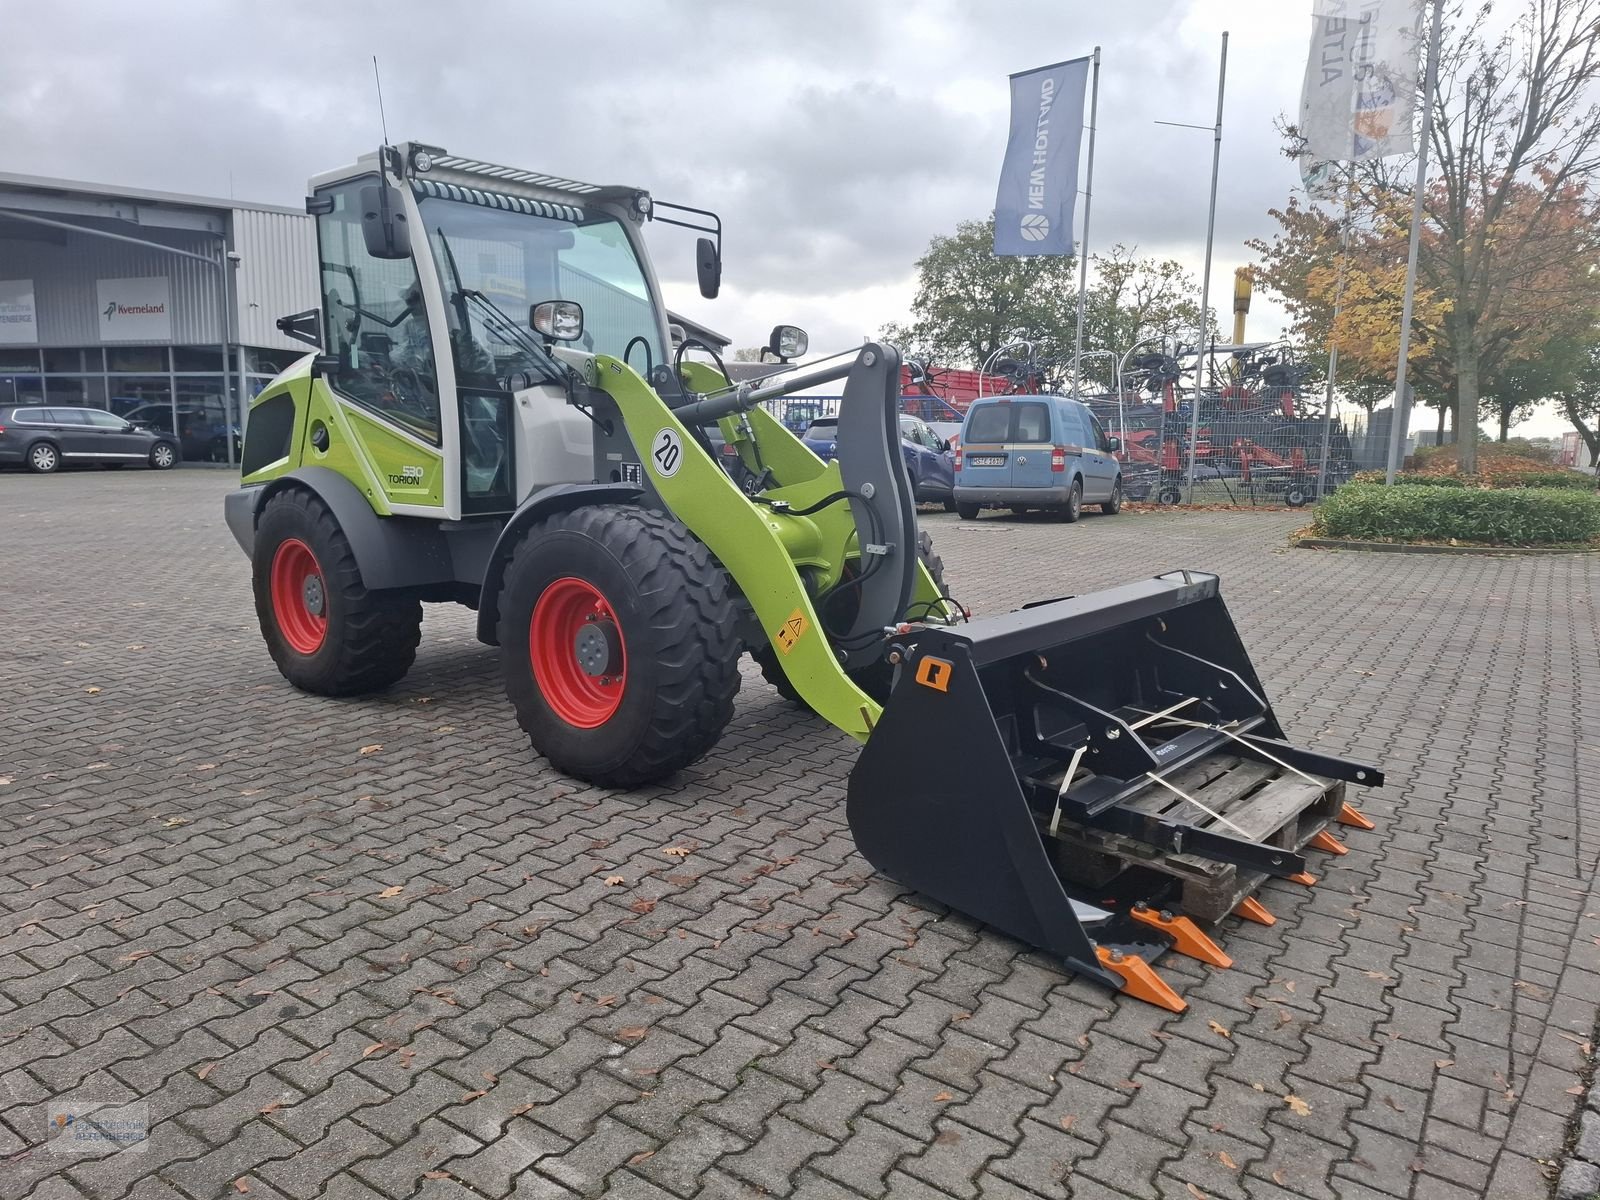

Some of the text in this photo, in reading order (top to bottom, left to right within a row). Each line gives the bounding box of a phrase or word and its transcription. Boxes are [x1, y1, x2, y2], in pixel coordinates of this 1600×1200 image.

[117, 303, 165, 315] Kverneland
[654, 433, 679, 471] 20
[402, 466, 424, 477] 530
[388, 475, 420, 485] TORION
